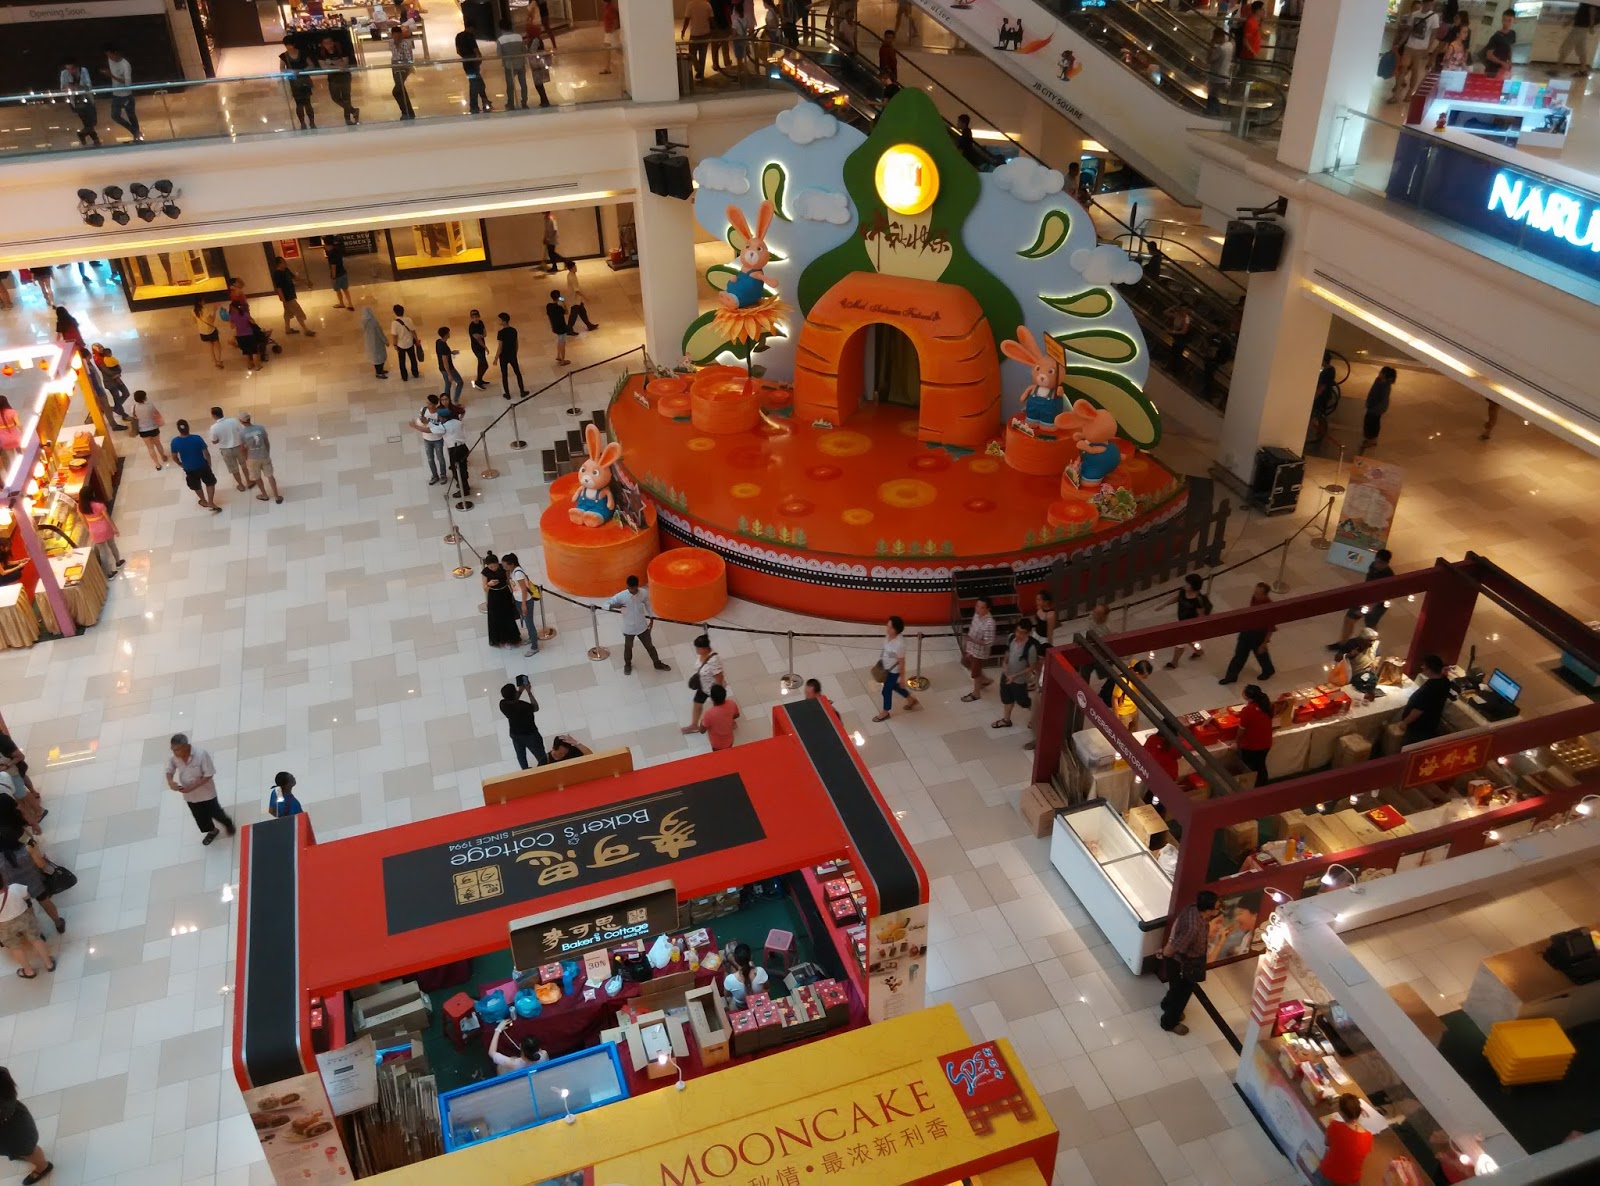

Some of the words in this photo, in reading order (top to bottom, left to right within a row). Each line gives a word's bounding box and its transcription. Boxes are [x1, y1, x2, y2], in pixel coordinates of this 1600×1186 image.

[29, 9, 65, 19] Opening
[65, 7, 86, 16] Soon
[1032, 82, 1042, 91] JB
[1041, 87, 1057, 101] CITY
[1056, 98, 1083, 120] SQUARE
[1487, 173, 1600, 253] NARU
[1089, 707, 1117, 742] OVERSEA
[1116, 738, 1150, 779] RESTORAN
[476, 831, 509, 846] SINCE
[563, 808, 651, 842] Baker's
[449, 840, 473, 852] 1994
[450, 832, 555, 866] Cottage
[561, 932, 601, 951] Baker's
[604, 923, 649, 939] Cottage
[588, 960, 607, 970] 30%
[660, 1079, 936, 1186] MOONCAKE
